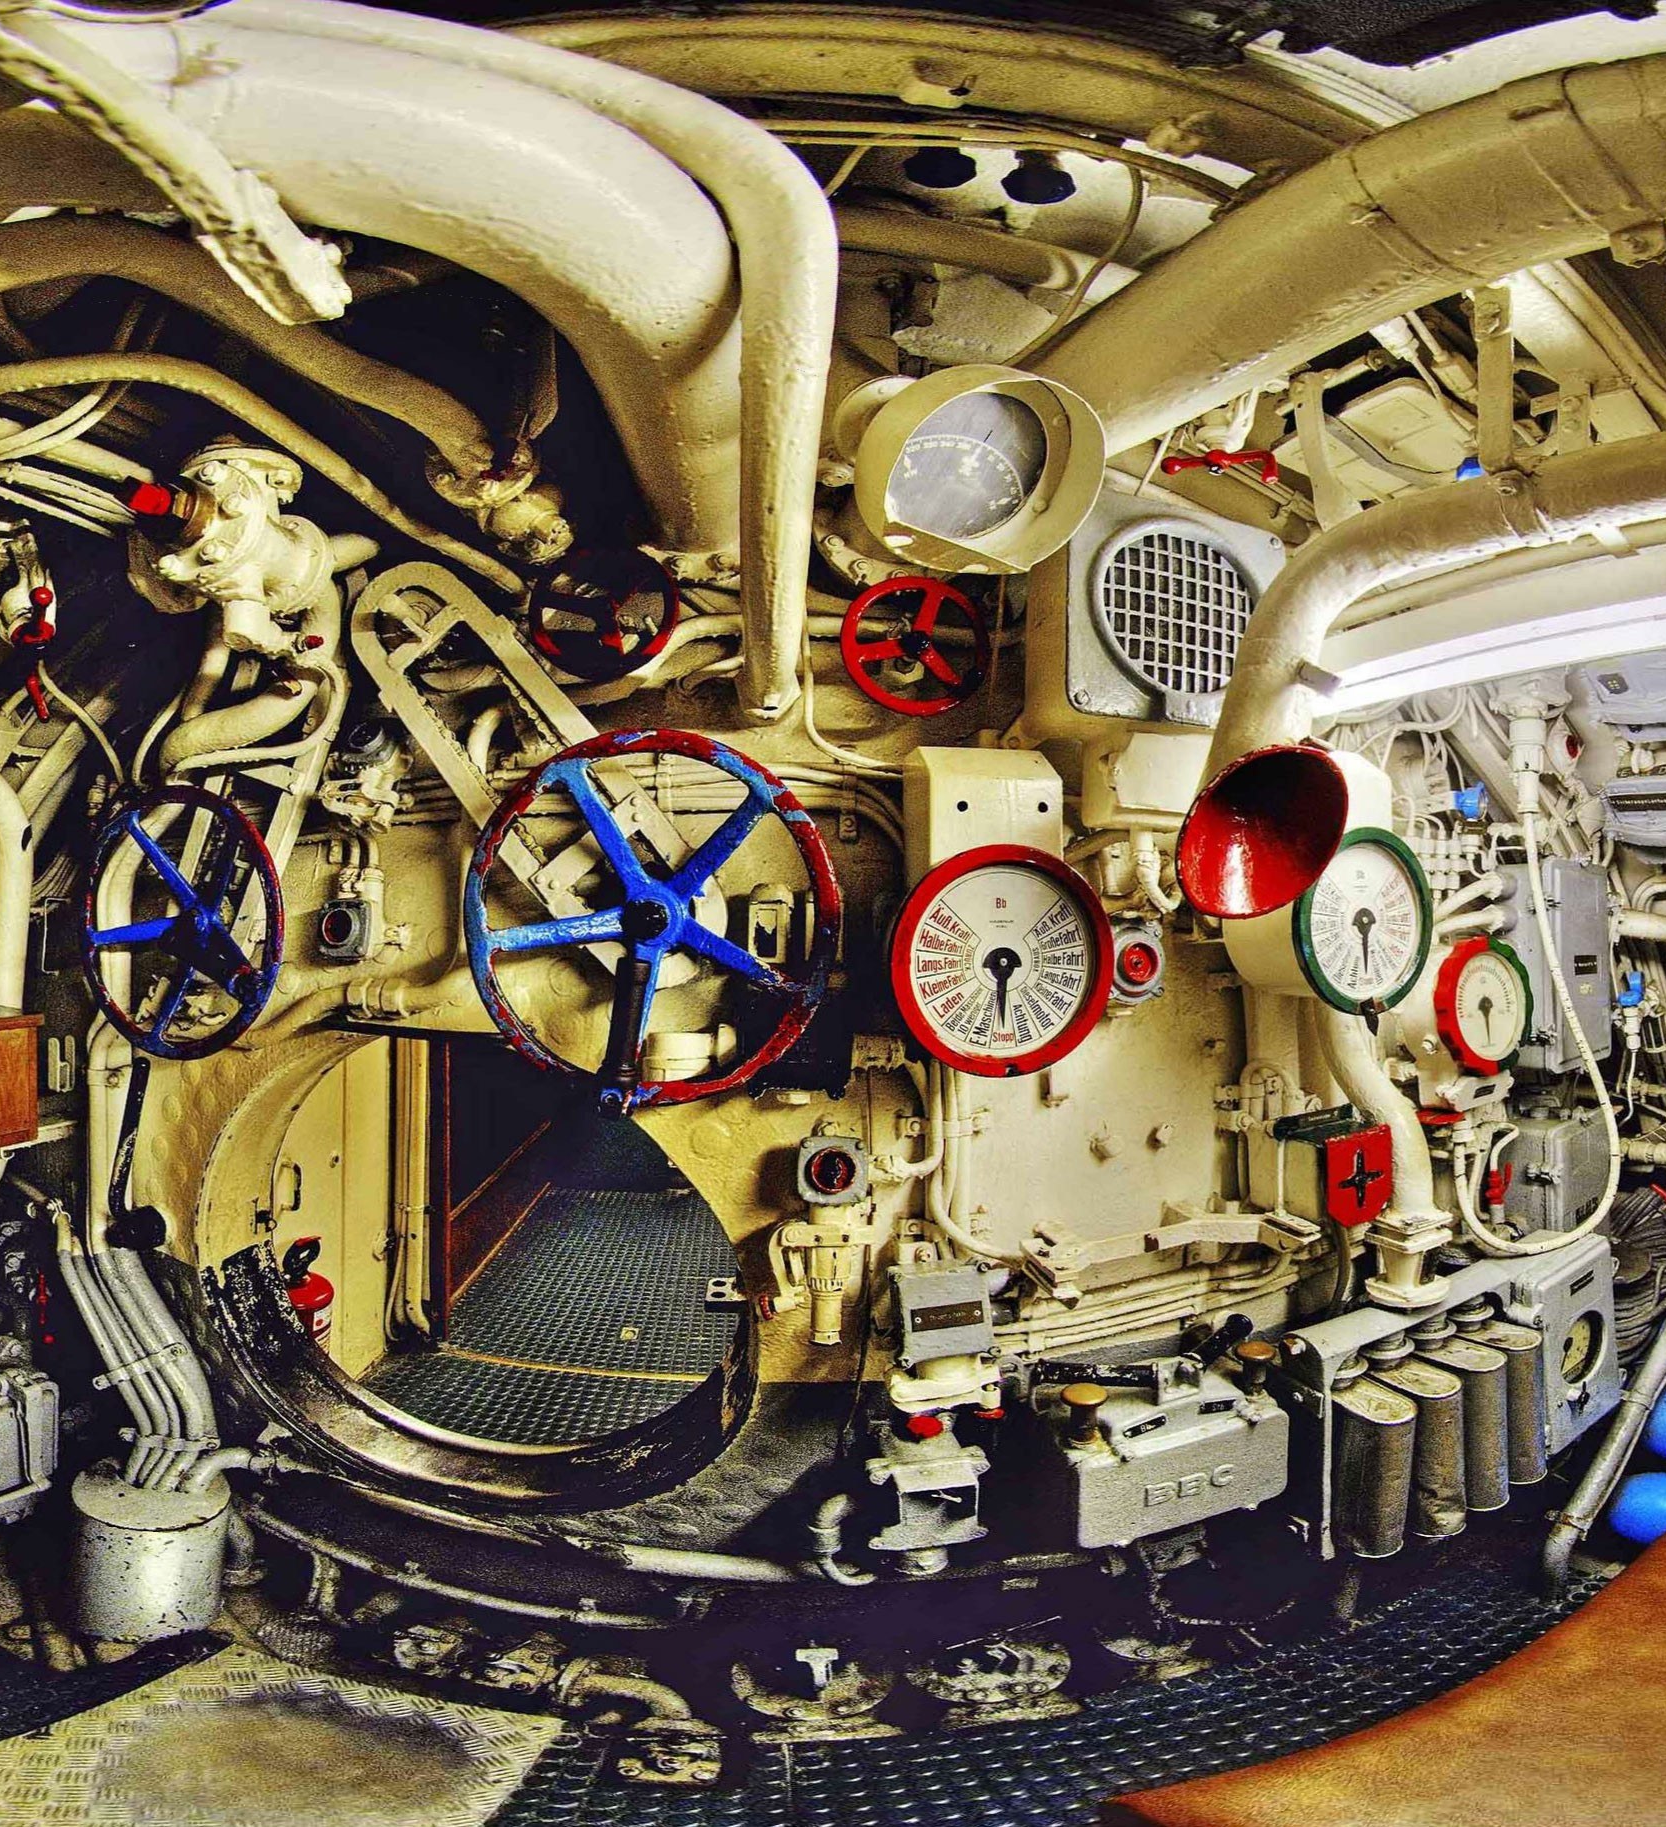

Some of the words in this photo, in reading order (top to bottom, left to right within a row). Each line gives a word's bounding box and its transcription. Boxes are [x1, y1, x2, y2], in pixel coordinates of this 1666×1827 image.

[995, 897, 1008, 909] Bb
[1048, 902, 1074, 926] Kraft
[919, 928, 946, 951] Halbe
[943, 938, 963, 955] Fahrt
[948, 921, 972, 942] Kraft
[1058, 924, 1082, 943] Fahrt
[943, 956, 962, 971] Fahrt
[1043, 953, 1062, 966] Halbe
[1062, 949, 1085, 967] Fahrt
[919, 979, 948, 1000] Kleine
[946, 972, 966, 989] Fahrt
[1060, 969, 1083, 992] Fahrt
[932, 991, 965, 1019] Laden
[1019, 985, 1055, 1031] Dieselmotor
[1050, 991, 1073, 1015] Fahrt
[957, 1023, 970, 1035] 10
[1012, 1003, 1033, 1044] Achtung
[993, 1031, 1015, 1043] Stopp
[1144, 1463, 1235, 1507] BBC
